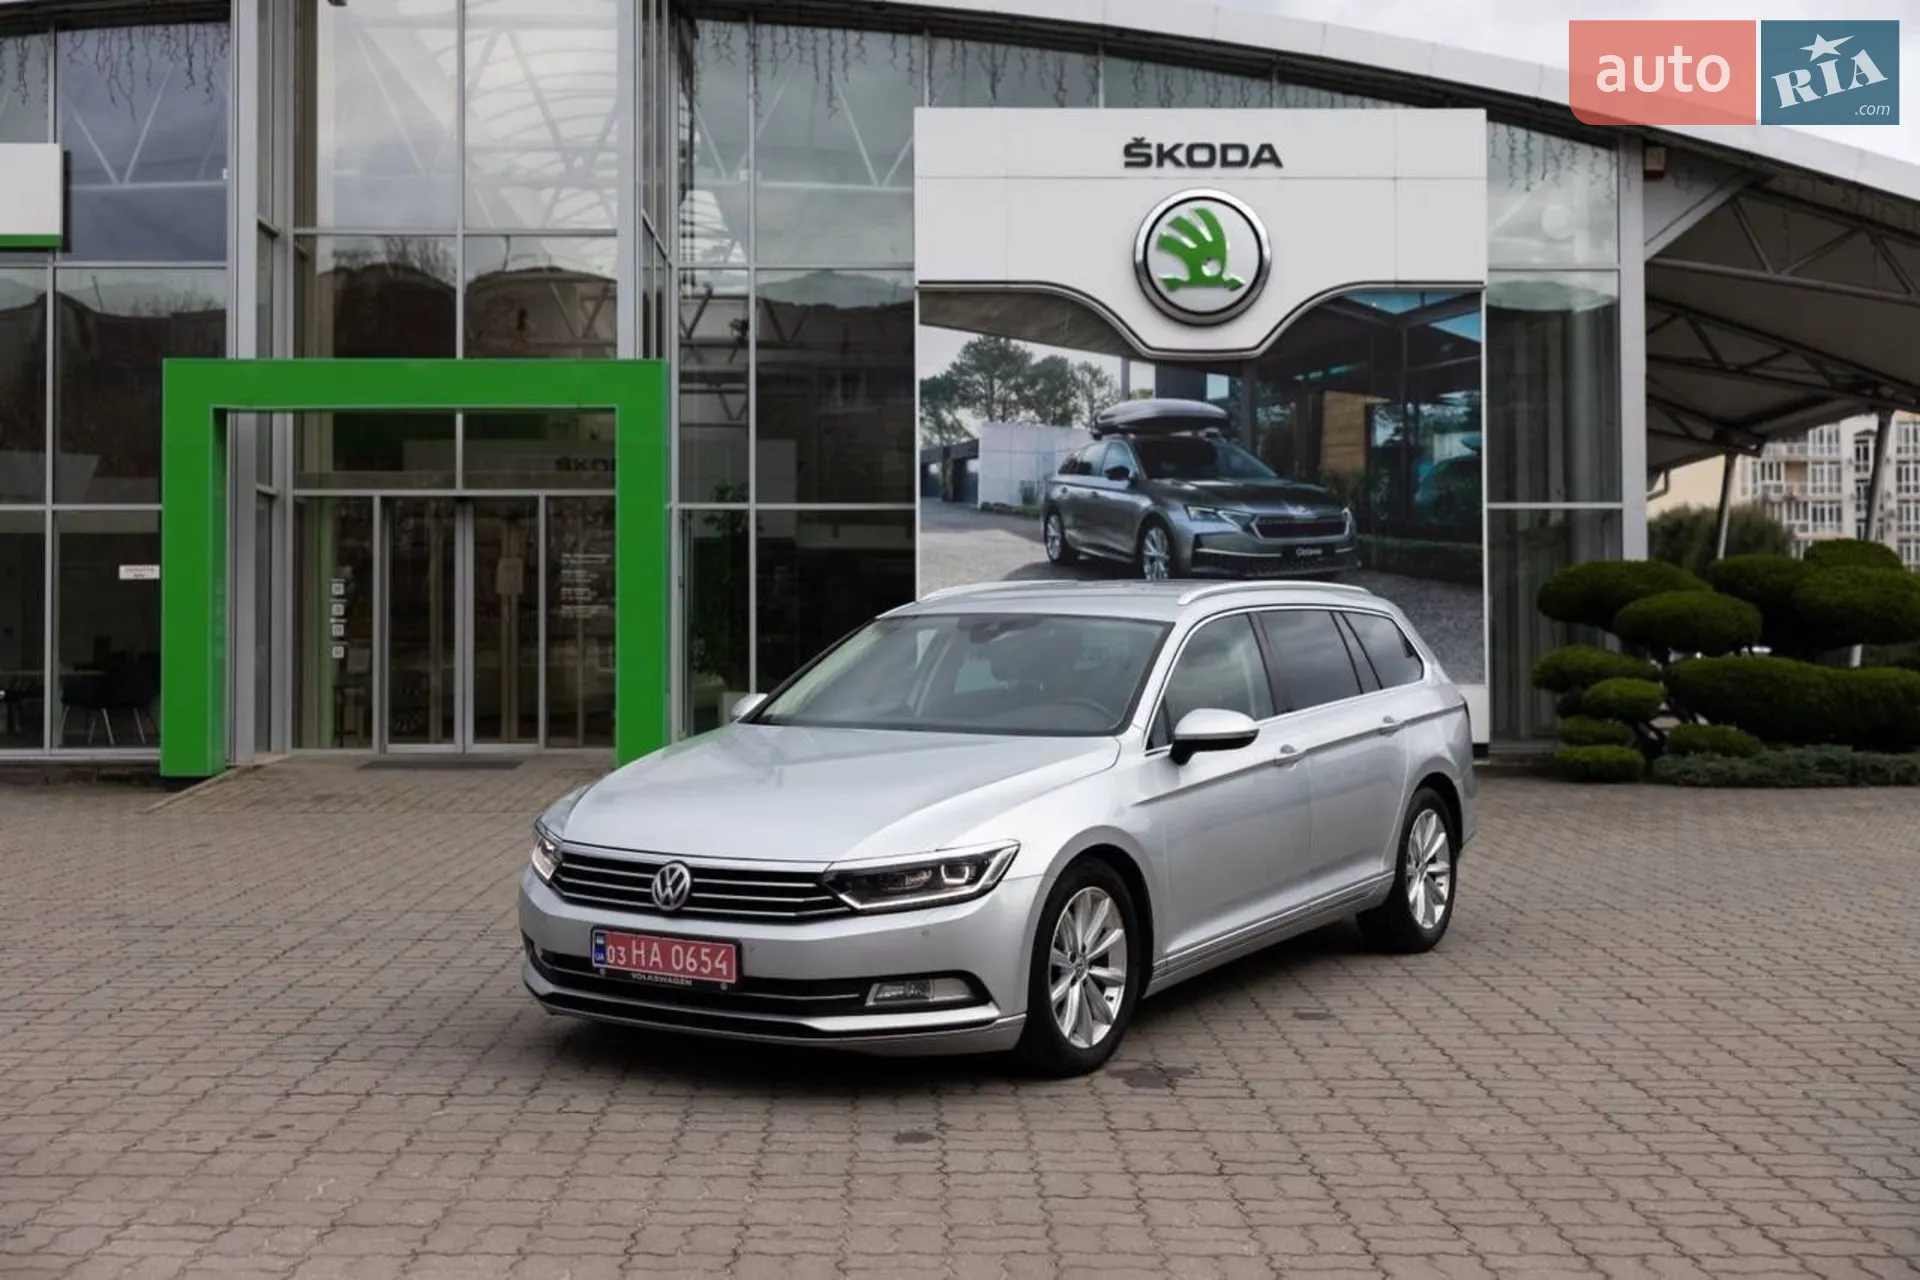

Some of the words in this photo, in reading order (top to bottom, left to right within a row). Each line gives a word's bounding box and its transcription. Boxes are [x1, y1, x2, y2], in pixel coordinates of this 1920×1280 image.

[1123, 136, 1284, 169] ŠKODA
[652, 863, 690, 910] VW
[606, 945, 626, 966] 03
[631, 939, 662, 969] HA
[671, 944, 728, 976] 0654
[631, 973, 692, 986] VOLKSWAGEN
